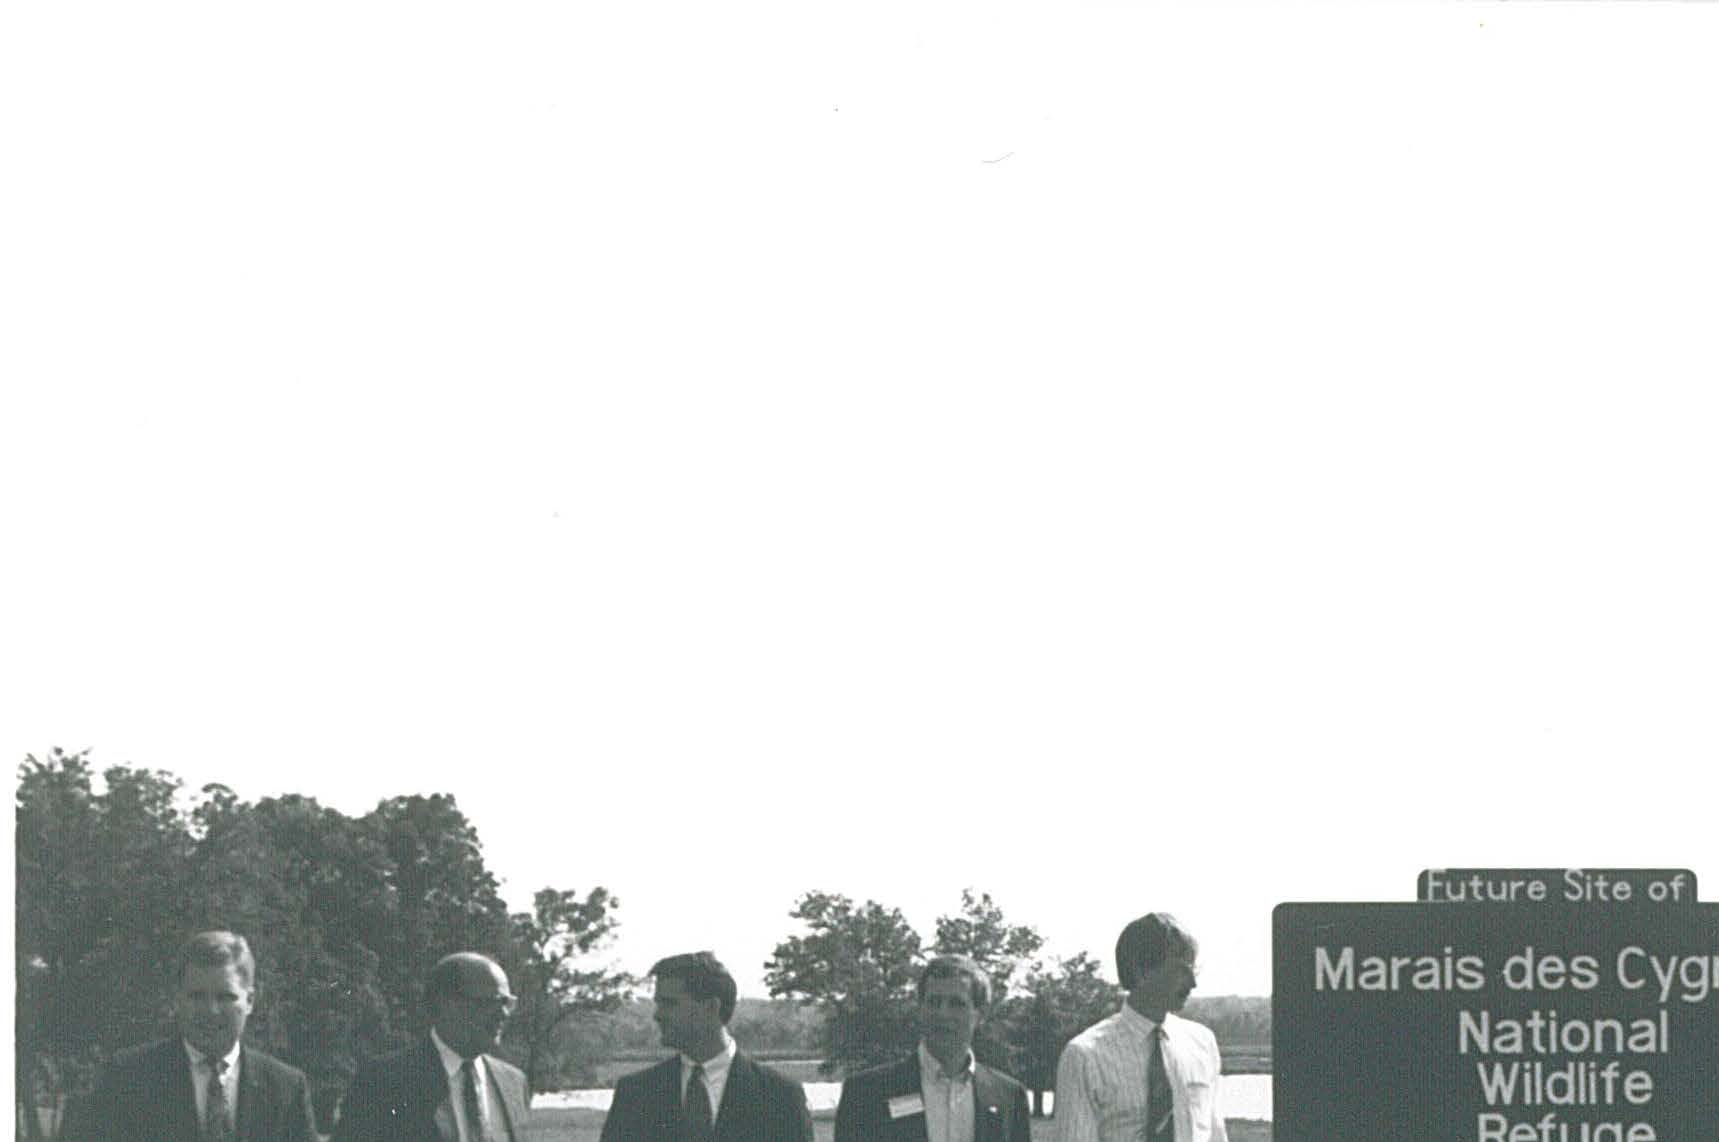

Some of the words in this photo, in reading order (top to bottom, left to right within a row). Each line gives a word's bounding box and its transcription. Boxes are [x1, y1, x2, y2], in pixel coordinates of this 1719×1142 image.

[1427, 869, 1547, 903] Future
[1563, 869, 1632, 902] Site
[1647, 873, 1686, 902] of
[1315, 946, 1485, 991] Marais
[1501, 946, 1599, 991] des
[1459, 1009, 1669, 1054] National
[1477, 1060, 1654, 1106] Wildlife
